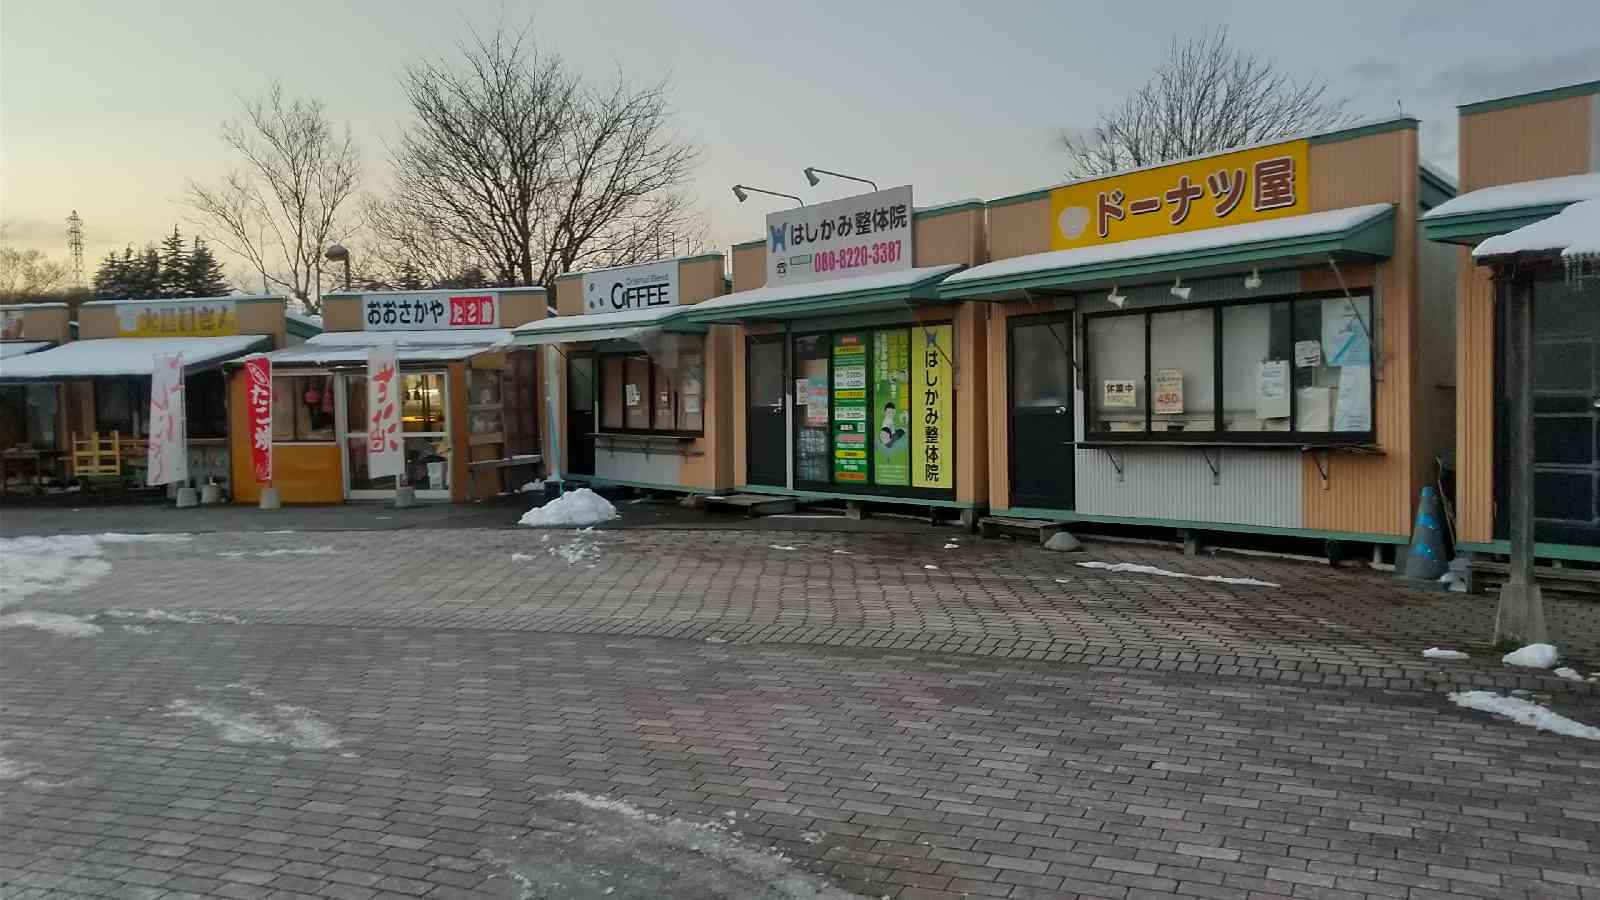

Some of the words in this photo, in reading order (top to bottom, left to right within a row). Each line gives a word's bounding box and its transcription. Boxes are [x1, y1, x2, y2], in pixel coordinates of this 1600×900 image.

[1097, 156, 1295, 237] ドーナツ屋
[790, 203, 907, 246] はしかみ整体院
[814, 240, 901, 273] 080-8220-3387
[367, 299, 445, 325] おおさかや
[924, 350, 940, 482] はしかみ整体院
